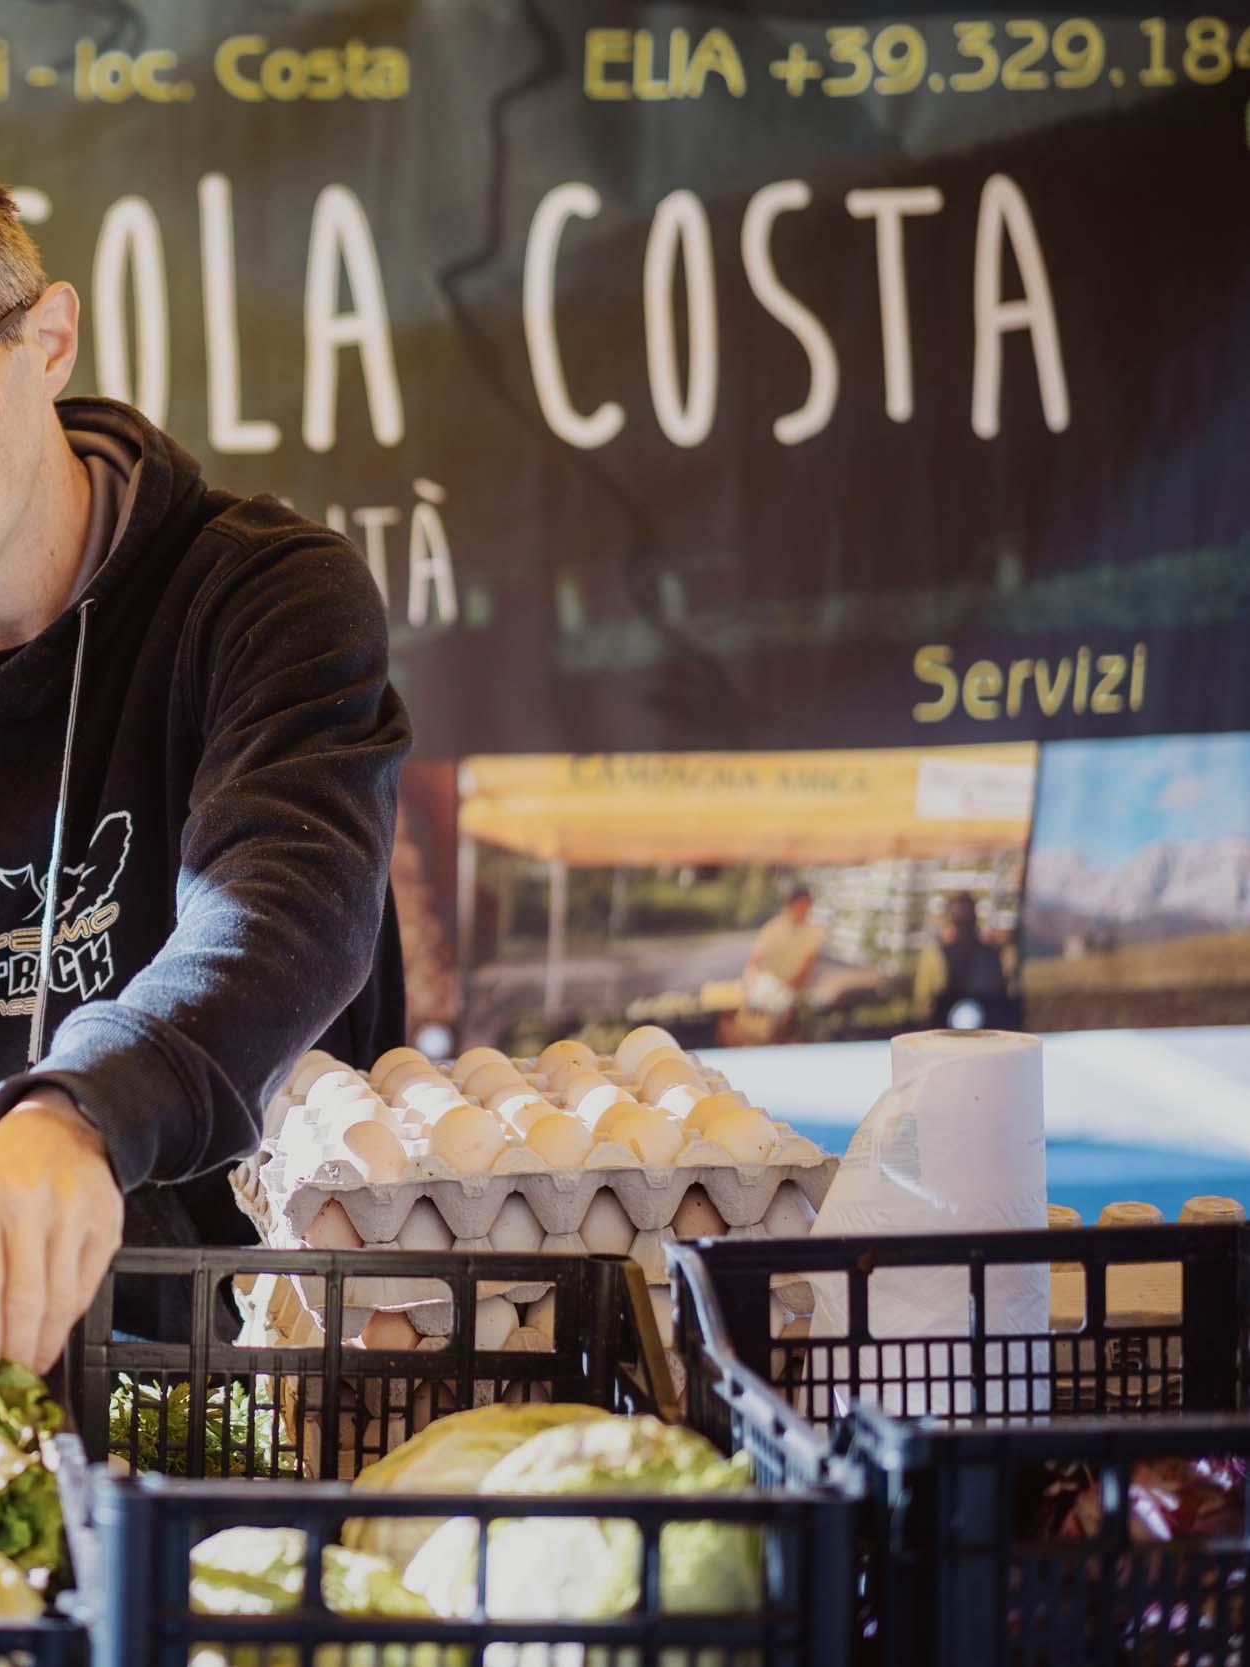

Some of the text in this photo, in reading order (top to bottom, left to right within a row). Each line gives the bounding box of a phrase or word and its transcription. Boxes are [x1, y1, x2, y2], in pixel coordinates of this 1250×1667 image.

[75, 39, 194, 103] loc.
[215, 33, 410, 102] Costa
[584, 28, 746, 101] ELIA
[522, 173, 1070, 450] COSTA
[912, 641, 1149, 725] Servizi
